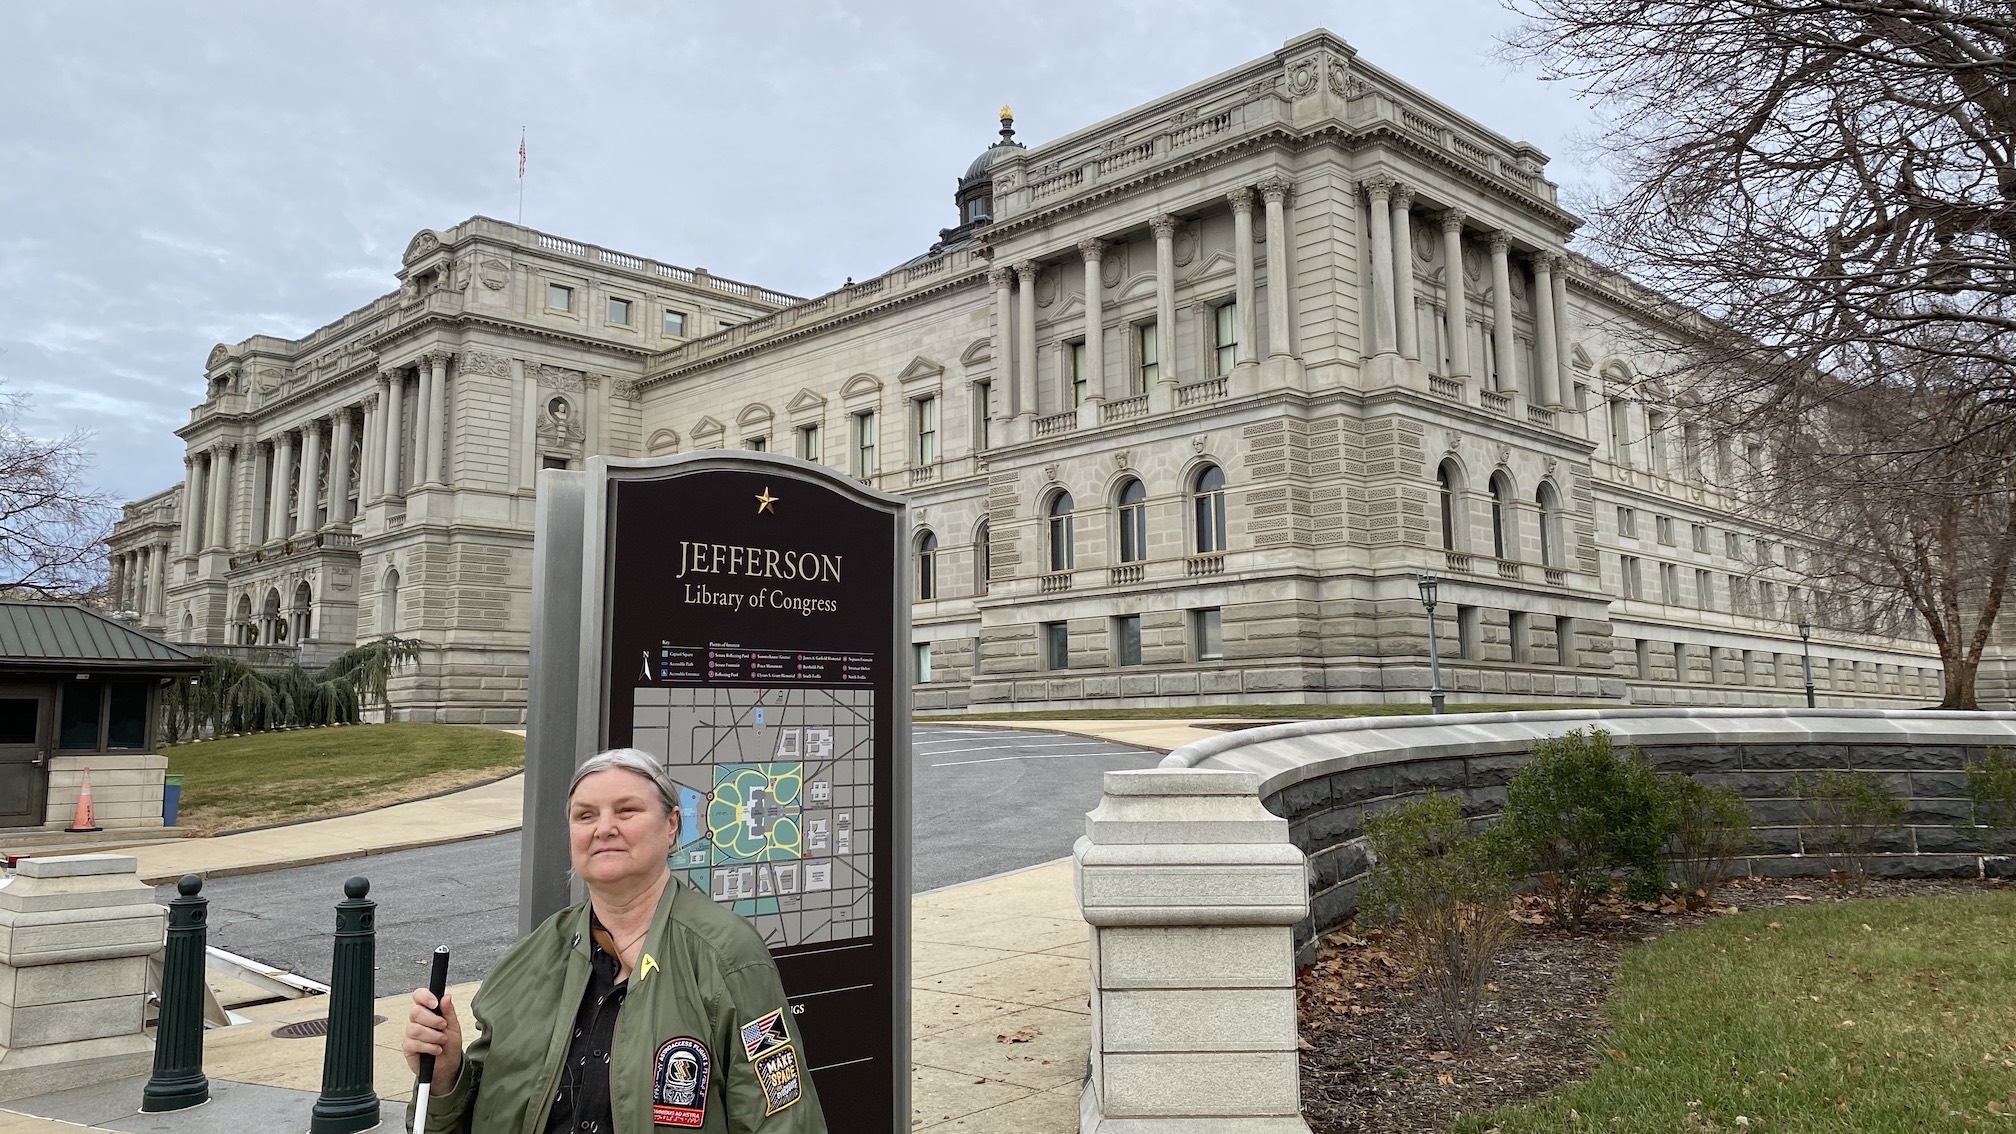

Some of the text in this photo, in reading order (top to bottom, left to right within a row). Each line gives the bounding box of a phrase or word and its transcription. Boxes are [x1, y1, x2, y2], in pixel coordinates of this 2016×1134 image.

[675, 541, 843, 583] JEFFERSON
[684, 583, 837, 617] Library of Congress
[659, 1040, 693, 1061] ASTROACCESS
[693, 1042, 708, 1060] FLIGHT
[766, 1052, 793, 1074] MAKE
[772, 1064, 796, 1087] SPACE
